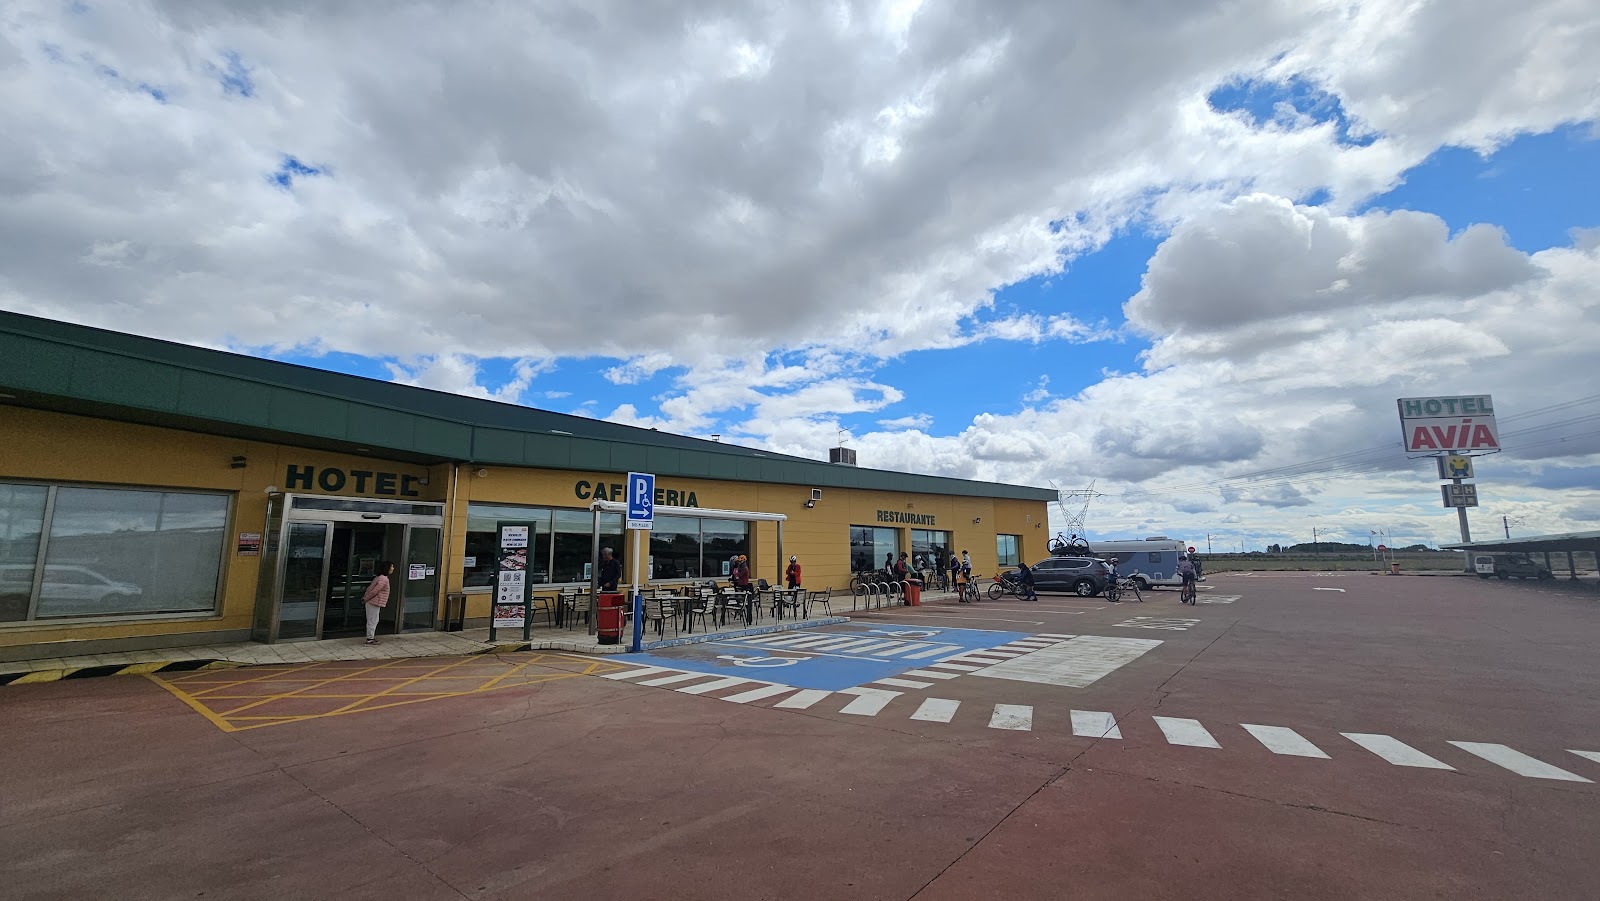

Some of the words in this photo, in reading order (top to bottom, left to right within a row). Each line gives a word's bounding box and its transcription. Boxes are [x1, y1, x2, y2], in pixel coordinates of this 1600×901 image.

[1405, 398, 1494, 416] HOTEL
[285, 464, 419, 496] HOTEL
[636, 479, 647, 504] P
[575, 480, 699, 508] CAFERIA
[877, 510, 936, 525] RESTAURANTE
